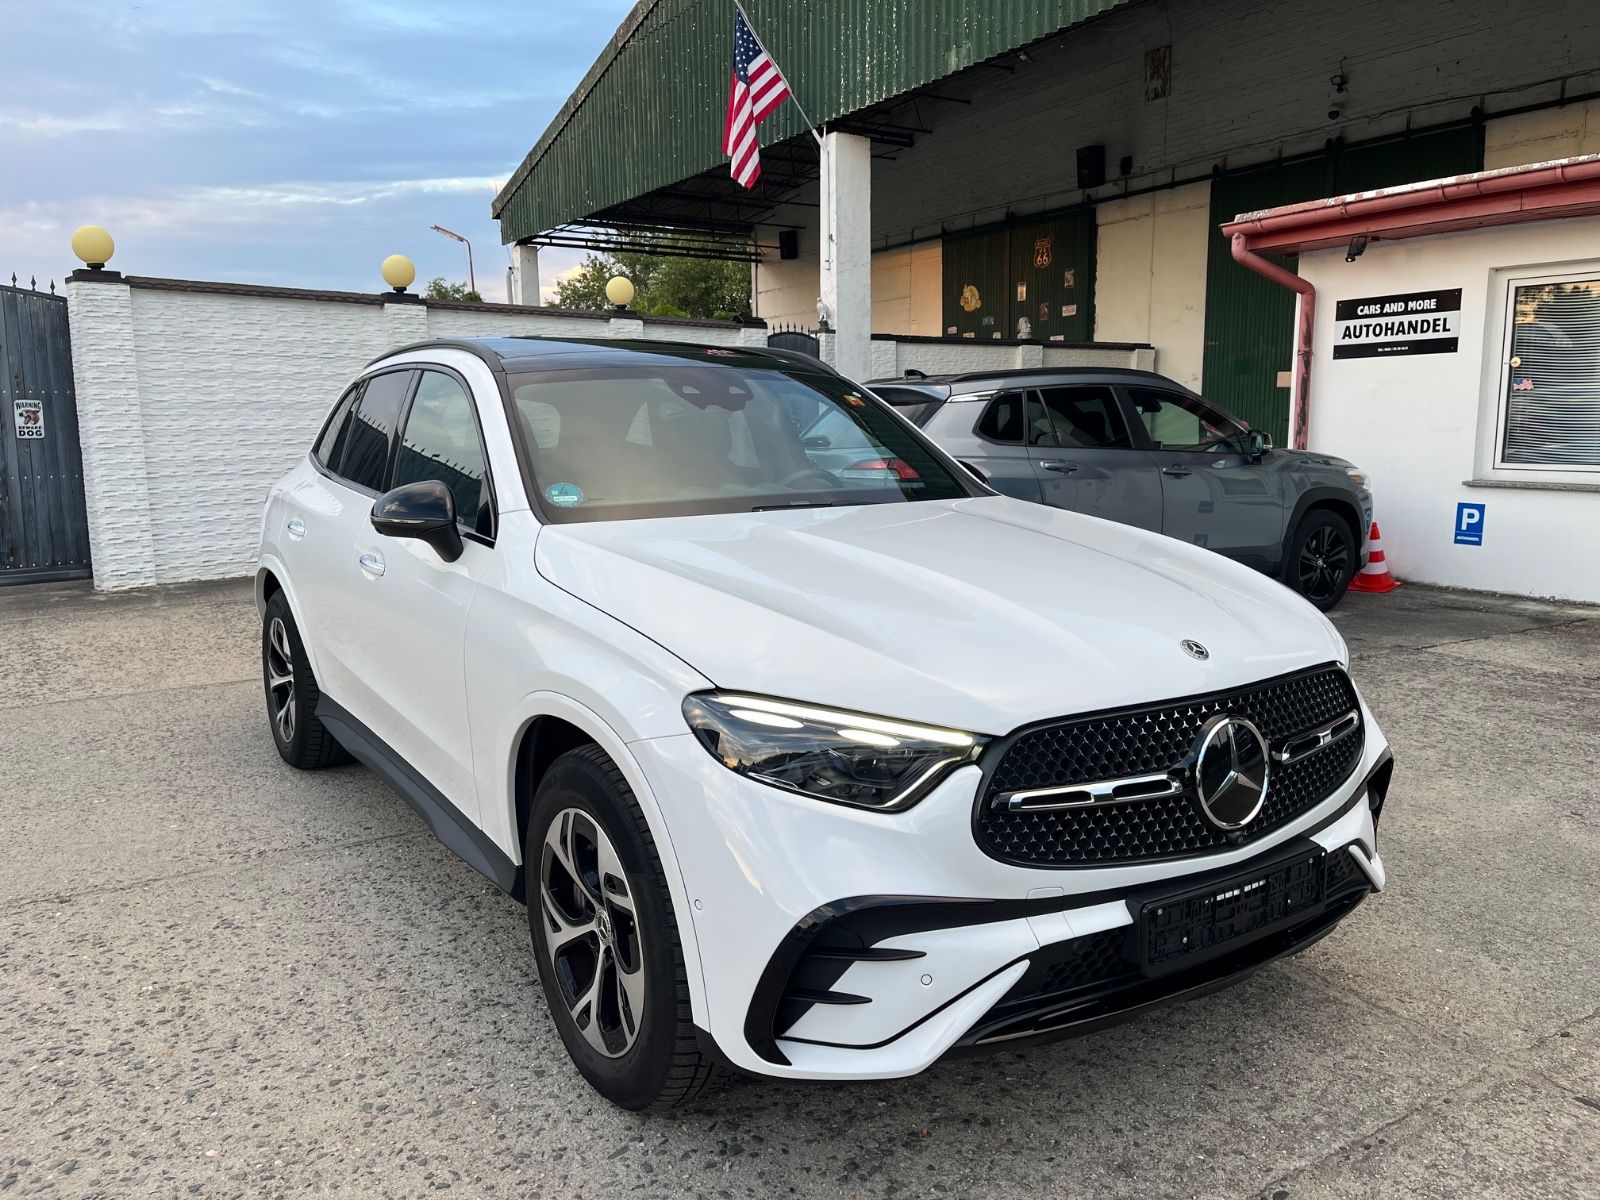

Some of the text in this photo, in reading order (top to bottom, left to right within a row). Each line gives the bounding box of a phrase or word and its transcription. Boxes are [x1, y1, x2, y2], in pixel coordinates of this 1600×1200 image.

[1036, 252, 1049, 266] 66
[1357, 298, 1438, 316] CARS AND MORE
[1341, 317, 1451, 340] AUTOHANDEL
[15, 401, 42, 411] WARNING
[1461, 507, 1480, 531] P
